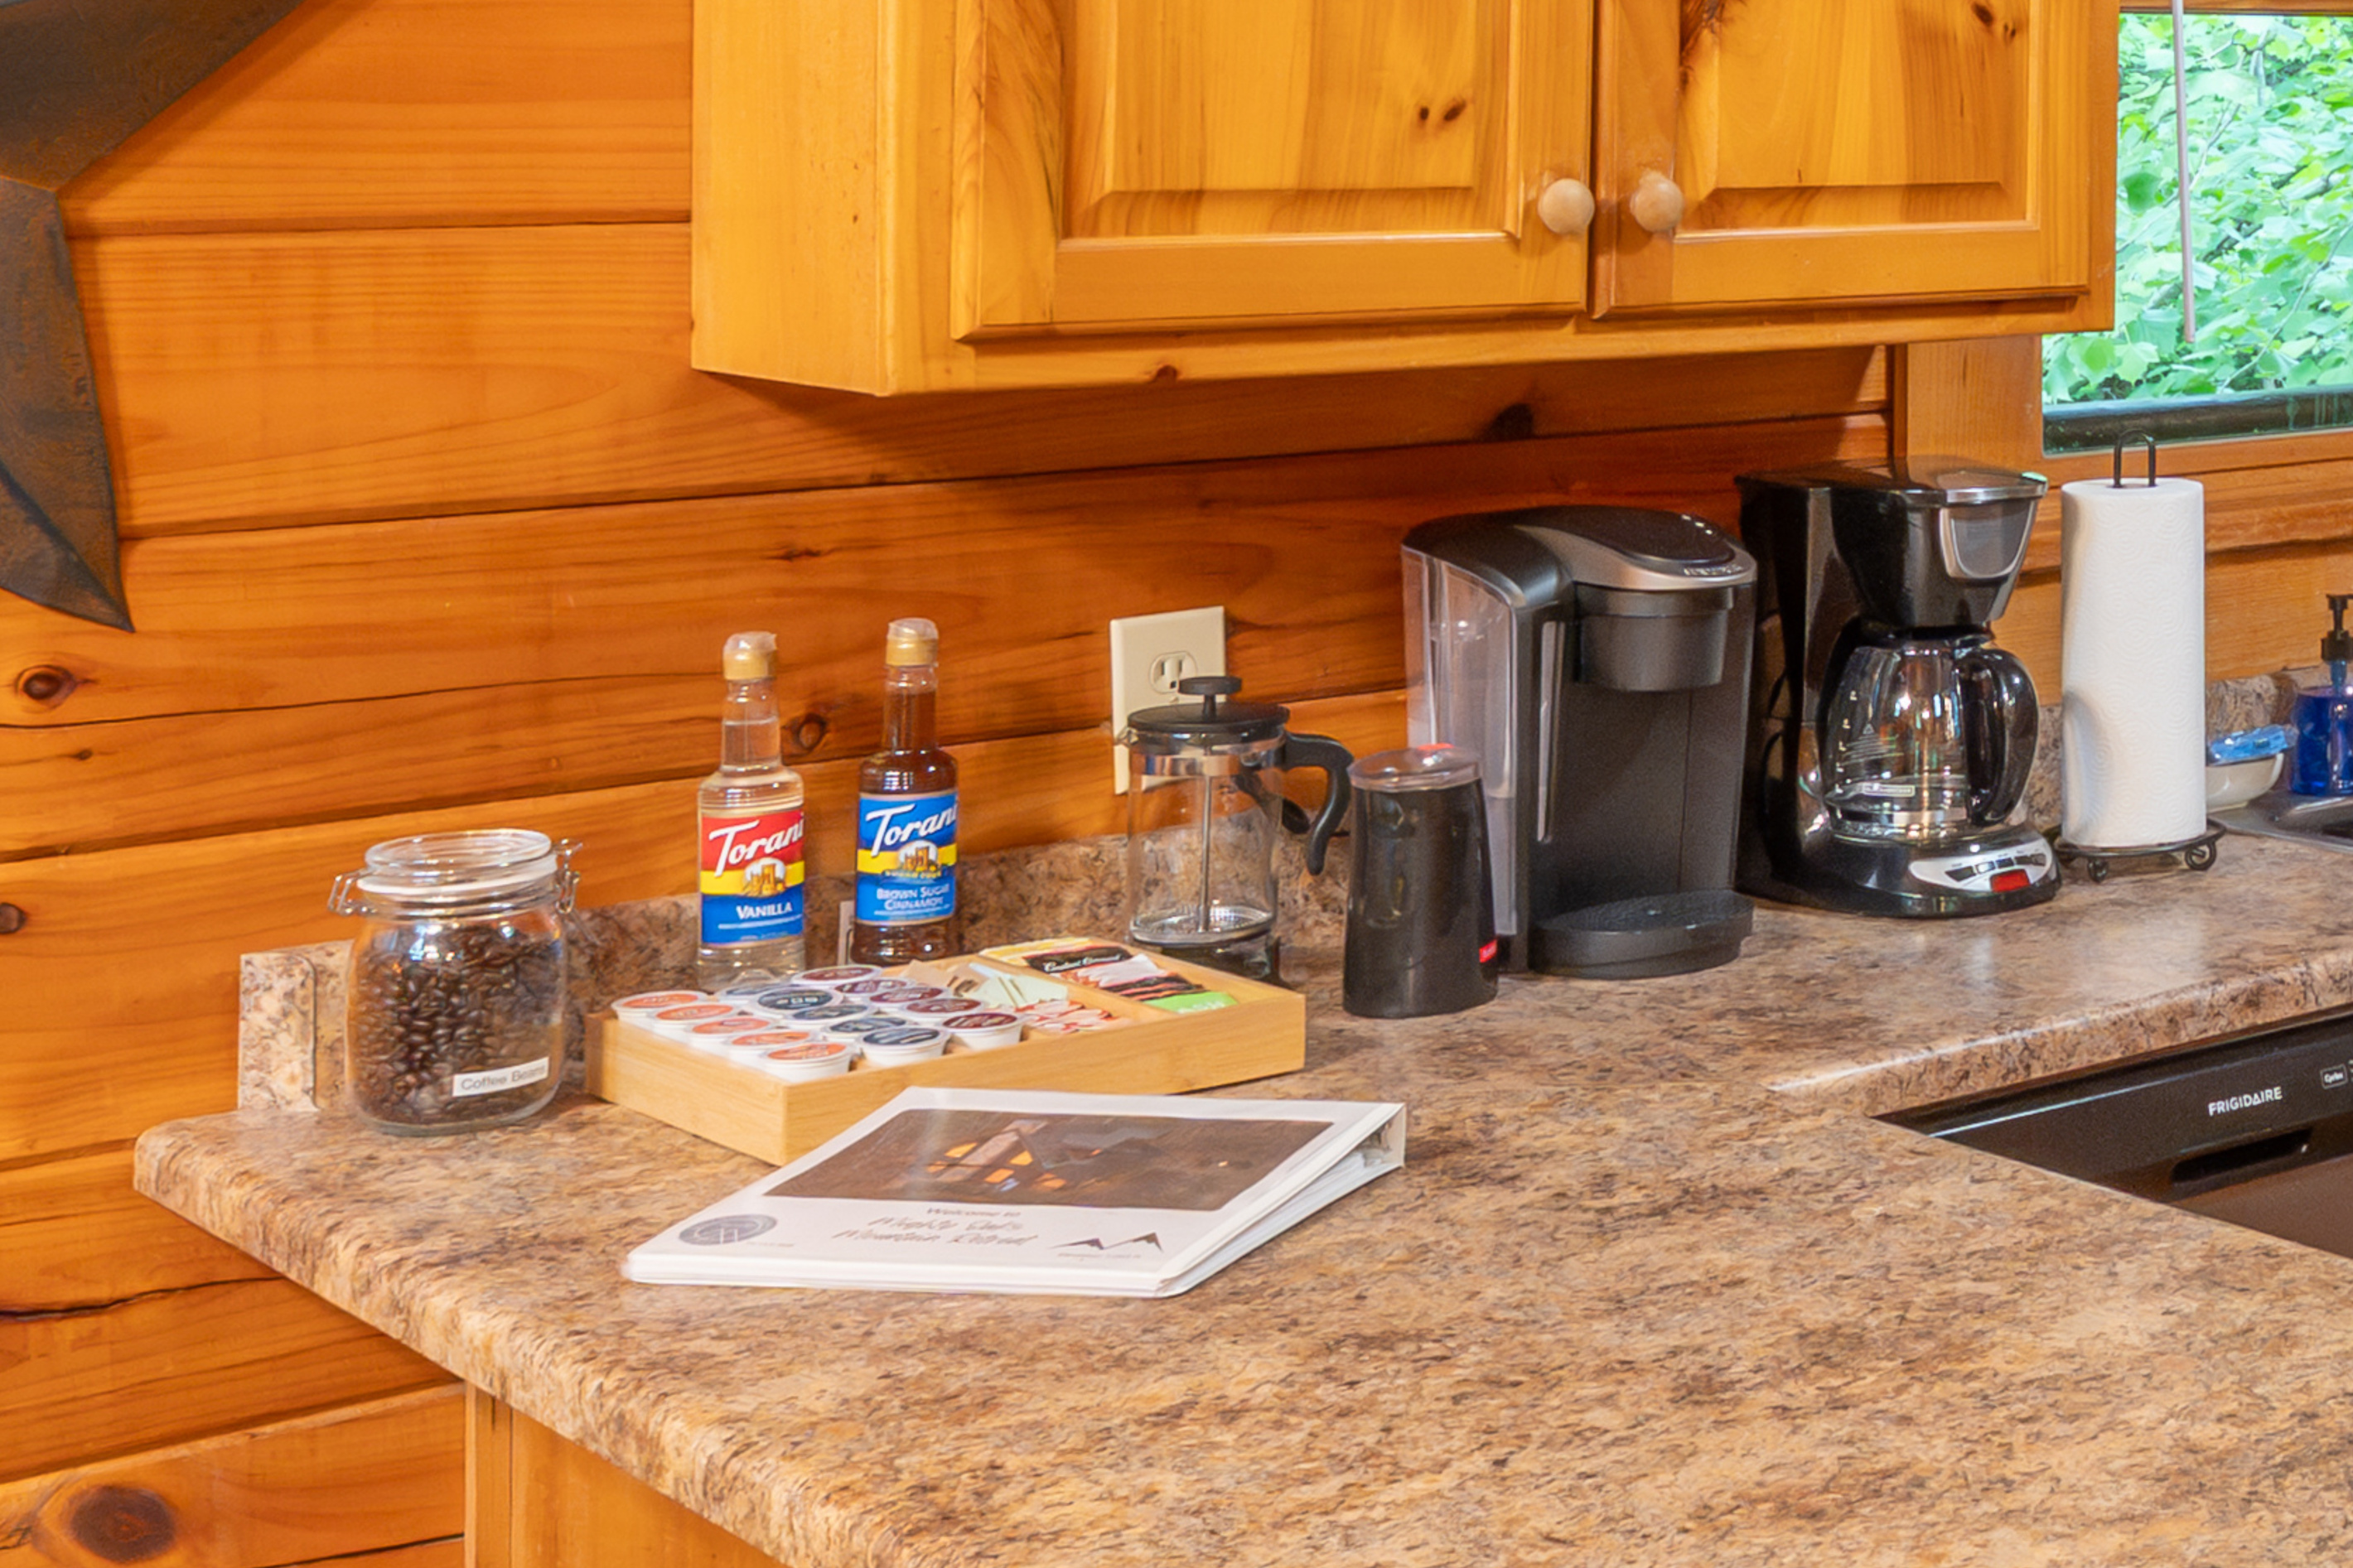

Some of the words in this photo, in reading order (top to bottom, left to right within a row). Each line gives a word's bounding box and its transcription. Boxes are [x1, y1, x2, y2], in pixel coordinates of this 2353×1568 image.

[736, 901, 793, 920] VANILLA
[461, 1076, 508, 1091] Coffee
[2208, 1086, 2283, 1117] FRIGIDAIRE
